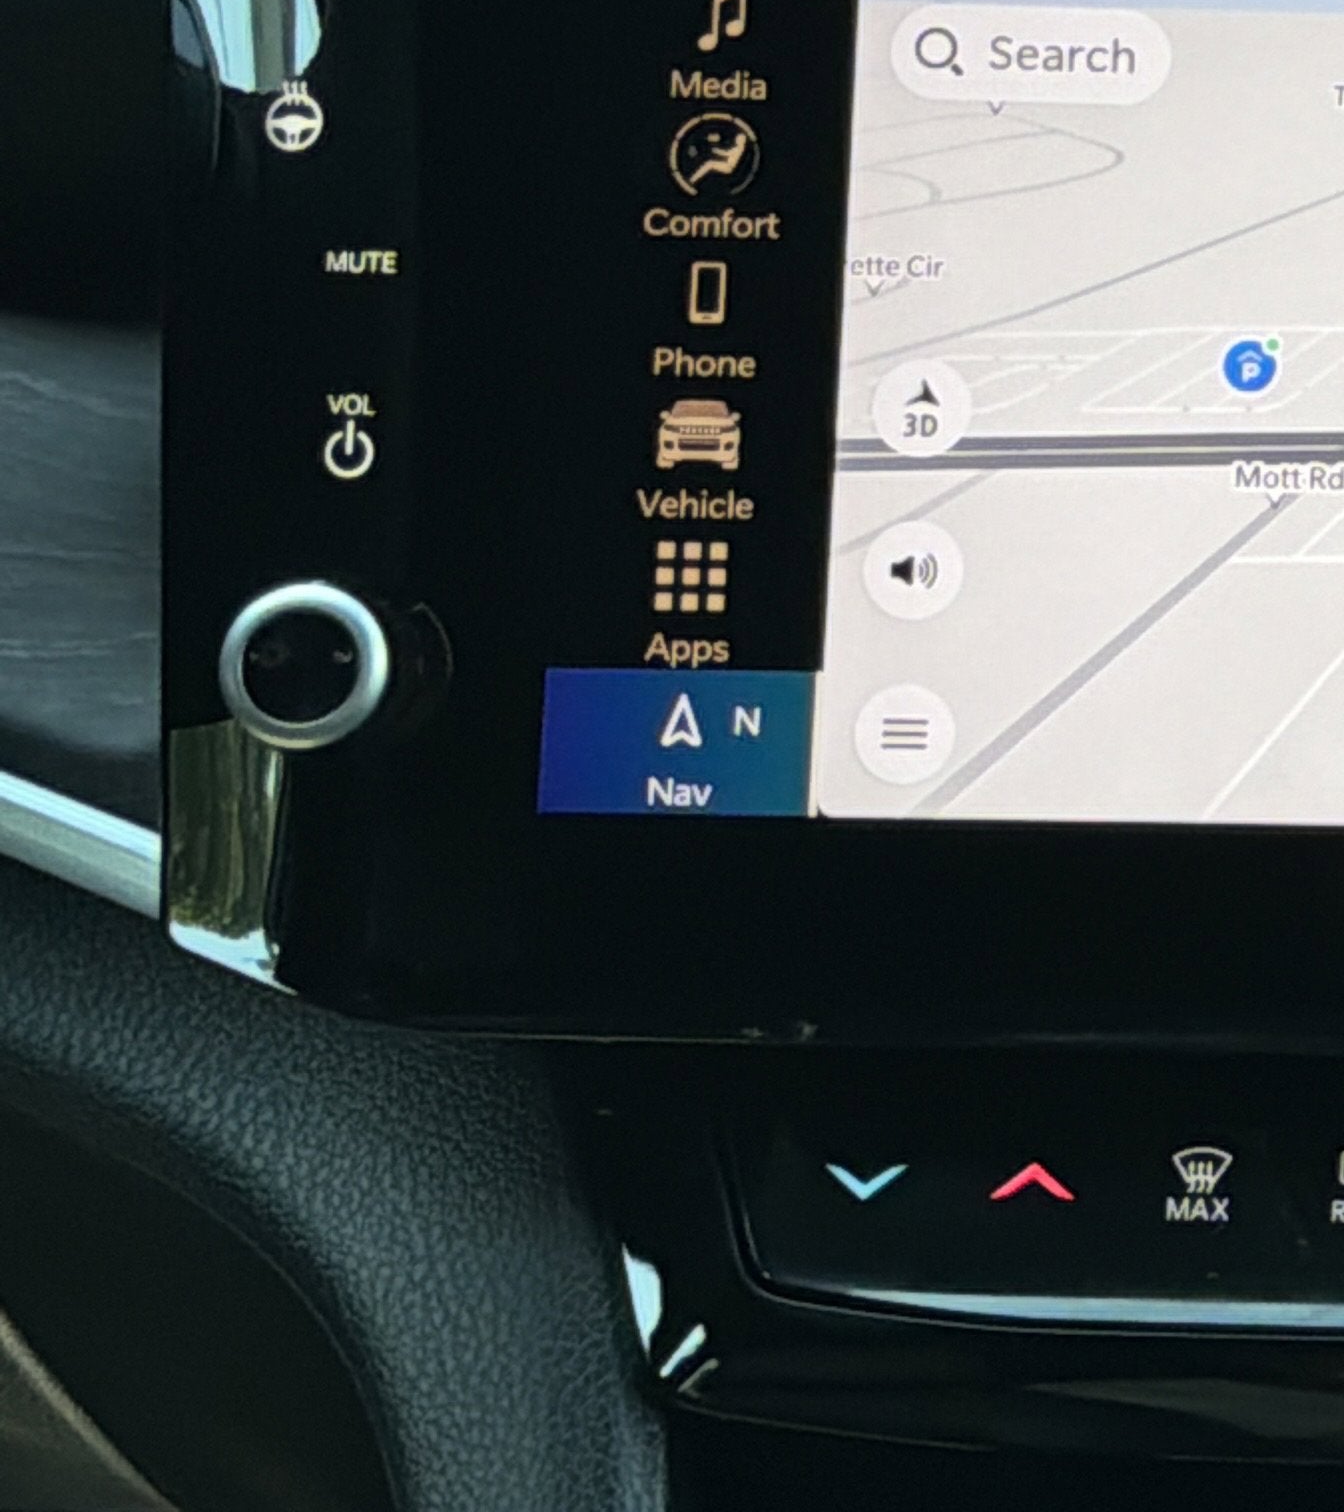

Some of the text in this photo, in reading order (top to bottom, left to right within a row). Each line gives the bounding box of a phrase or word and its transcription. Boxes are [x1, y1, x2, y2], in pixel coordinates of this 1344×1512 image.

[989, 35, 1137, 75] Search
[669, 70, 768, 101] Media
[643, 208, 780, 240] Comfort
[325, 250, 398, 275] MUTE
[906, 254, 944, 277] Cir
[653, 348, 756, 378] Phone
[327, 394, 375, 416] VOL
[903, 415, 937, 437] 3D
[1235, 464, 1344, 490] Mott Rd
[635, 490, 754, 520] Vehicle
[644, 633, 729, 668] Apps
[733, 704, 761, 737] N
[646, 778, 713, 809] Nav
[1165, 1197, 1229, 1223] MAX
